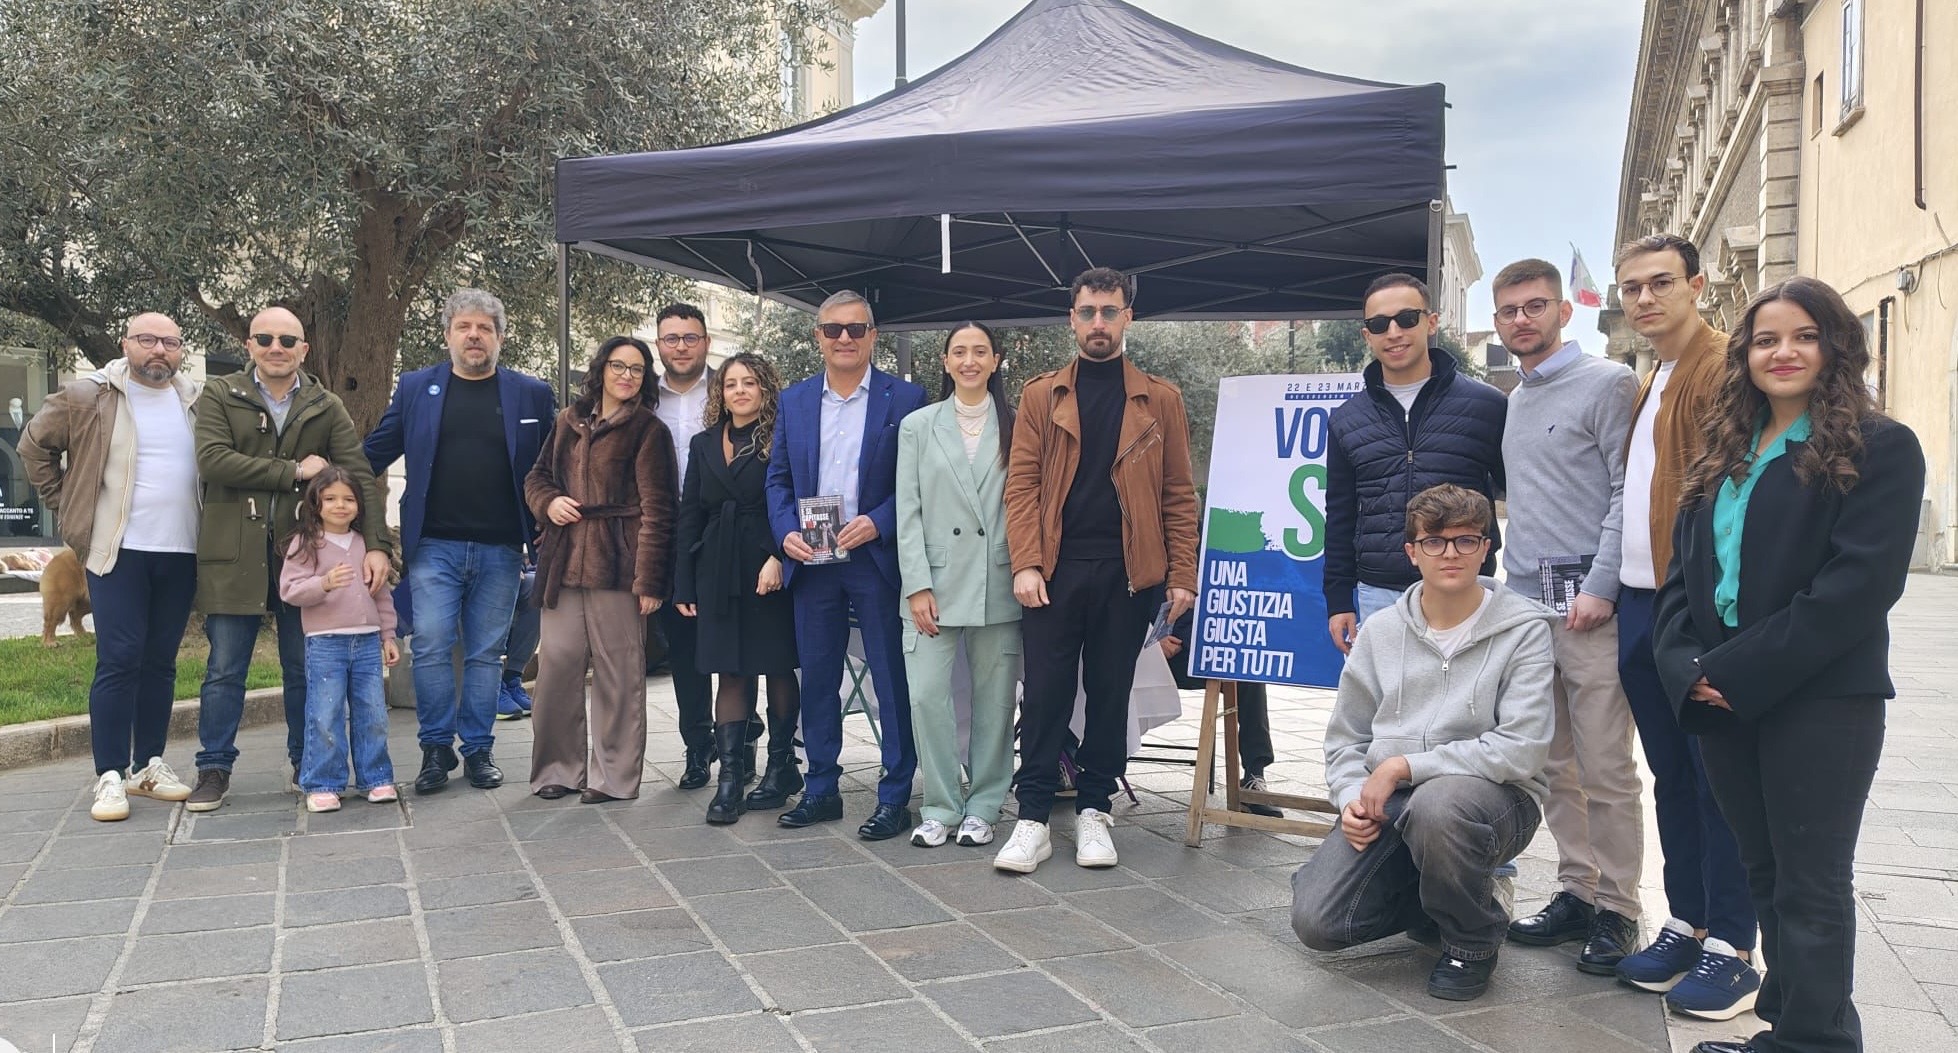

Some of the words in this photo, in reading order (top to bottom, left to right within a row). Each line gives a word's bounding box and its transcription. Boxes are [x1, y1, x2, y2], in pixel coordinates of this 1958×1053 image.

[1287, 383, 1300, 392] 22
[1306, 383, 1312, 392] E
[1318, 383, 1331, 392] 23
[1337, 382, 1367, 391] MARZ
[1275, 407, 1336, 459] VO
[1283, 463, 1327, 557] S
[1209, 560, 1247, 587] UNA
[1206, 588, 1293, 619] GIUSTIZIA
[1556, 601, 1567, 611] SE
[1564, 580, 1575, 612] PITASSE
[1203, 617, 1267, 646] GIUSTA
[1200, 645, 1237, 673] PER
[1240, 648, 1294, 678] TUTTI
